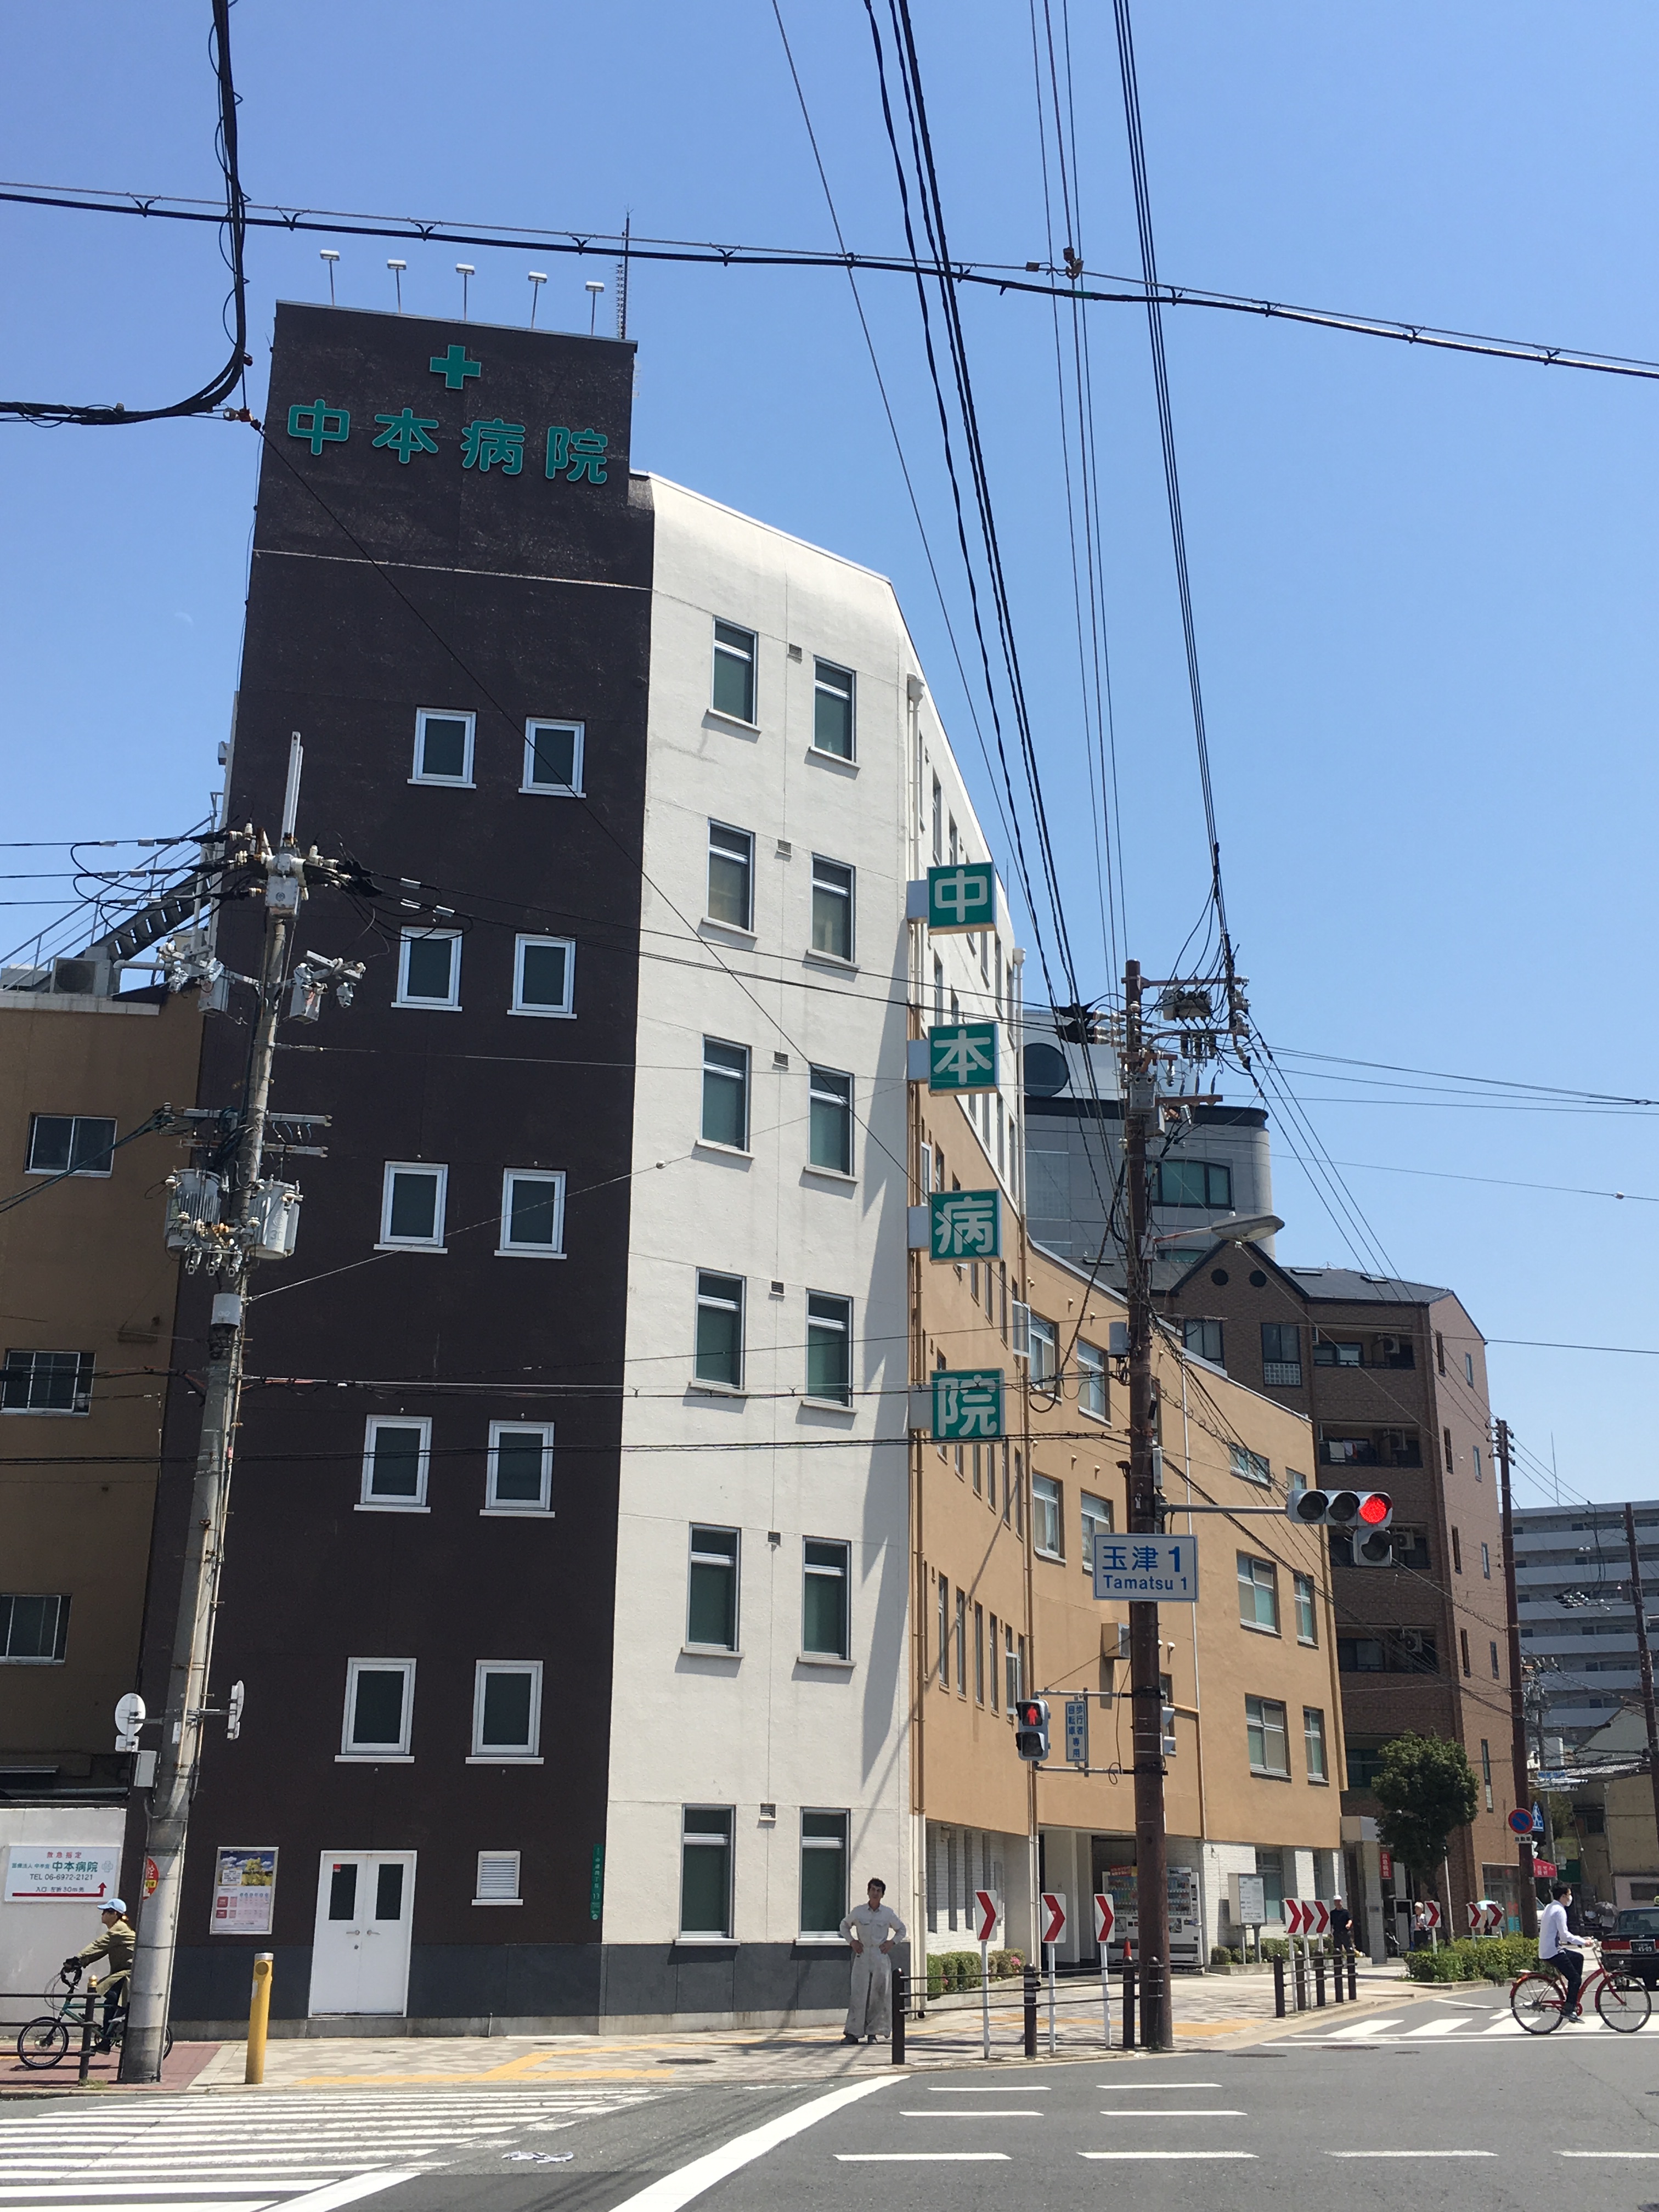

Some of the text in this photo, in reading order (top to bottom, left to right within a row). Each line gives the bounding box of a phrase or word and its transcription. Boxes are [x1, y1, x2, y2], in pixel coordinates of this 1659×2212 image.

[287, 399, 608, 484] 中本病院
[1102, 1545, 1159, 1572] 玉津
[1103, 1575, 1187, 1590] Tamatsu 1
[52, 1861, 99, 1872] 中本病院
